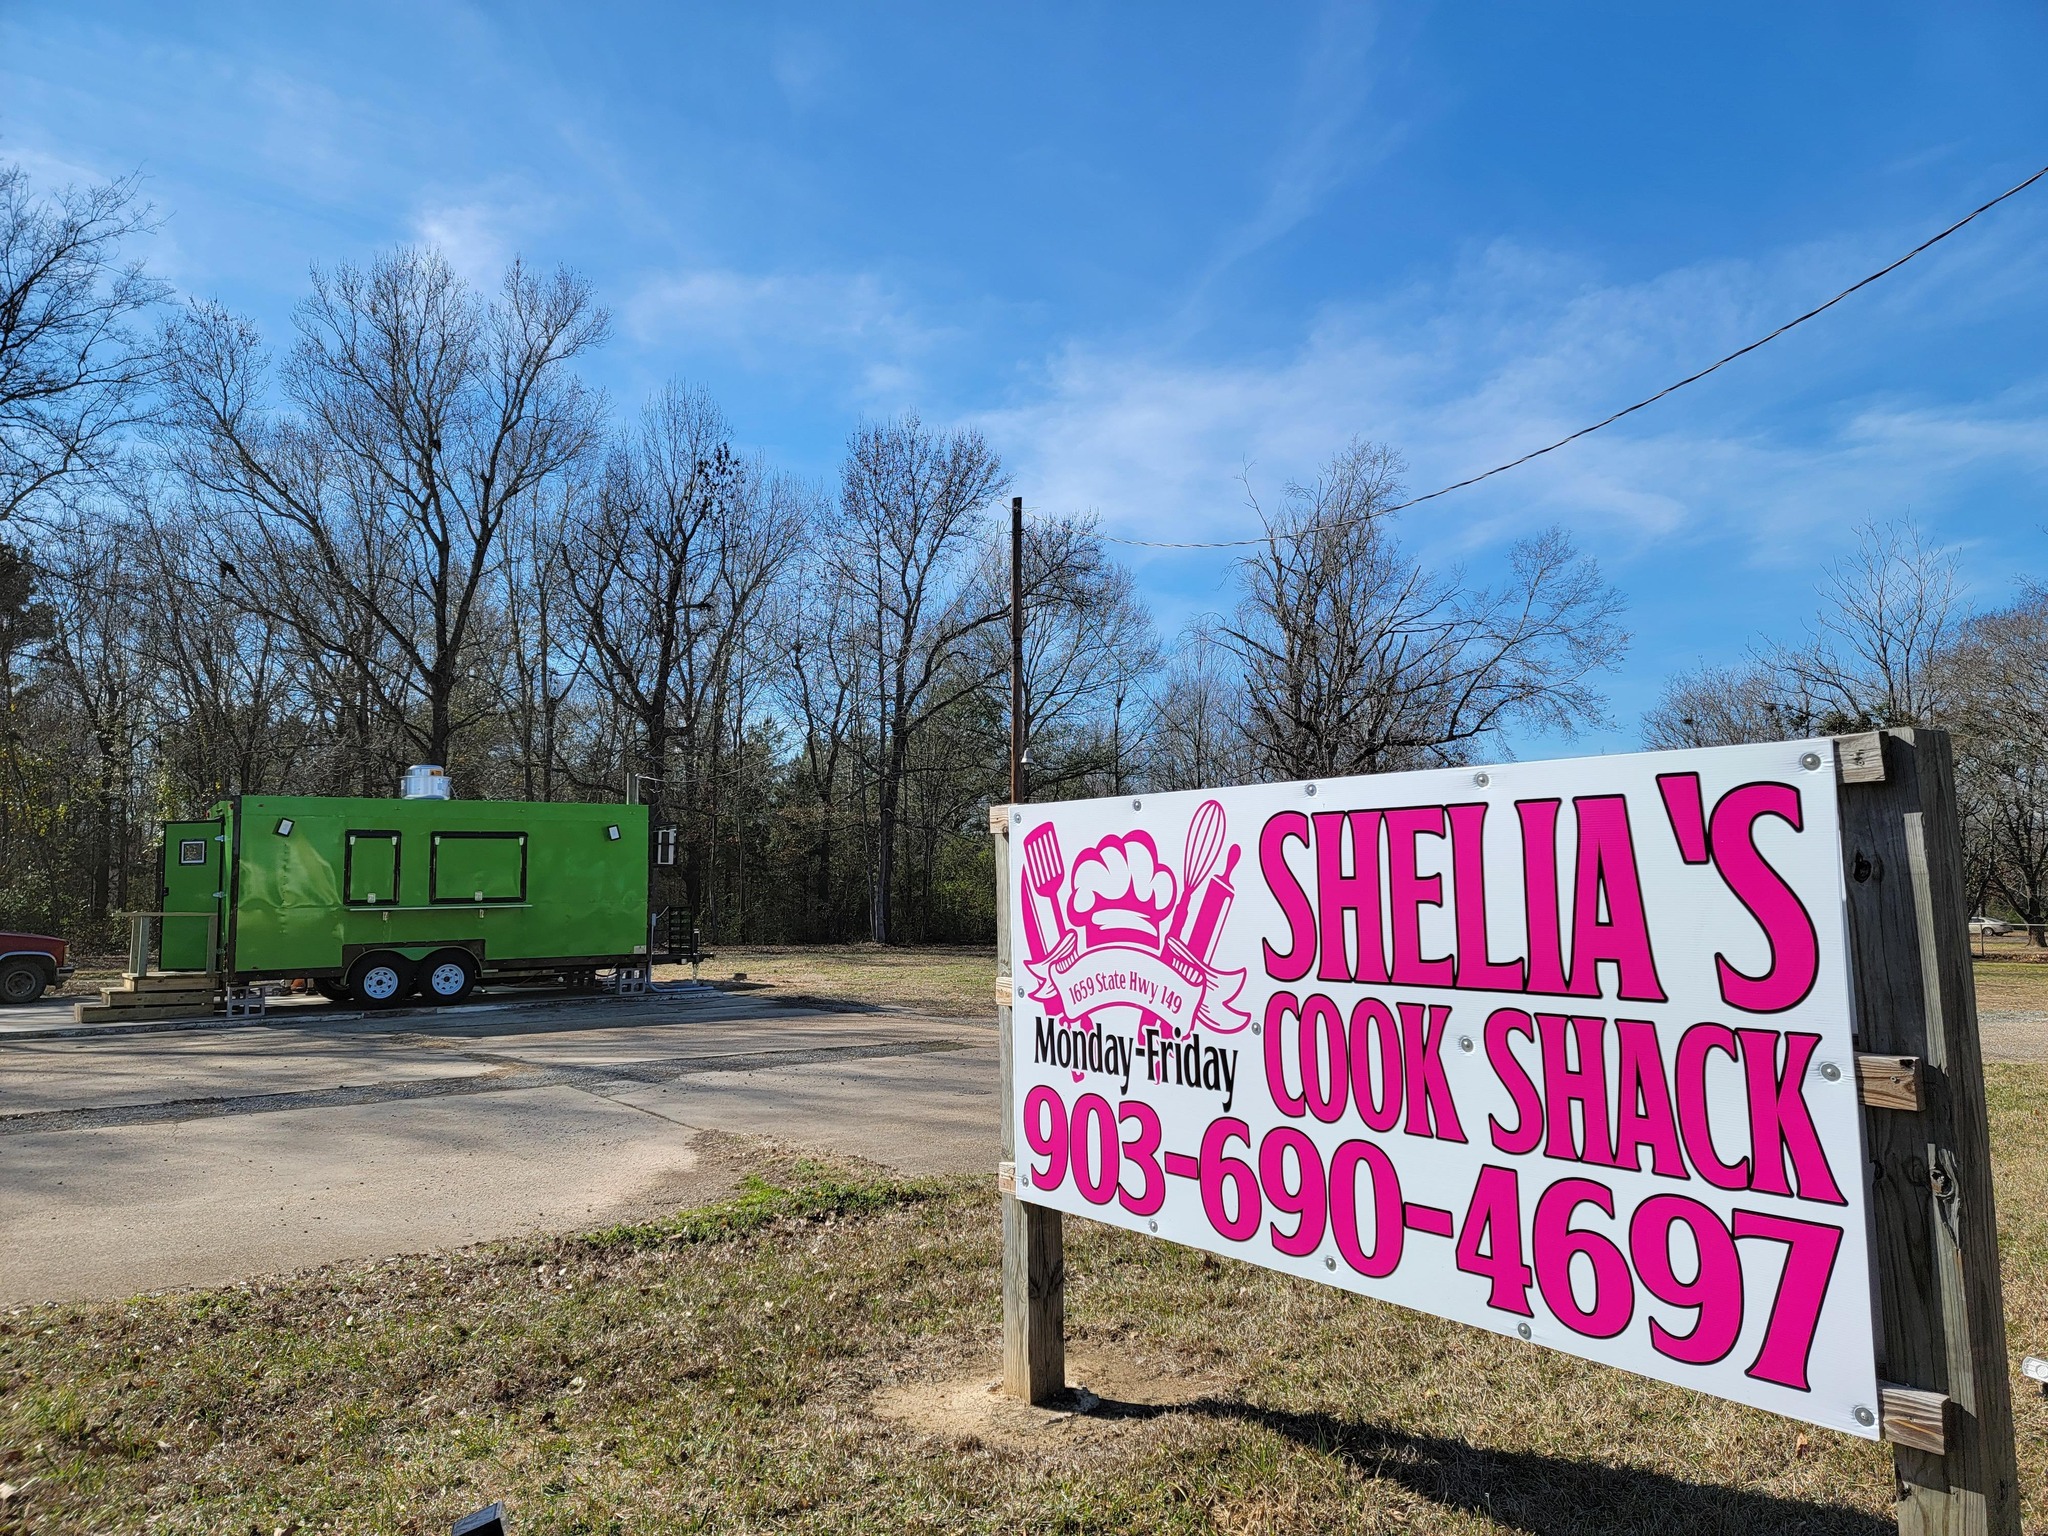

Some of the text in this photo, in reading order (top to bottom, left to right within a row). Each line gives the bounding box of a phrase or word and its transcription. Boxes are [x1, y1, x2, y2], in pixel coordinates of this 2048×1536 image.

[1068, 970, 1183, 1014] 1659 State Hwy 149
[1259, 772, 1820, 1014] SHELIA'S
[1034, 1016, 1239, 1113] Monday-Friday
[1263, 990, 1849, 1206] COOK SHACK
[1023, 1084, 1844, 1392] 903-690-4697
